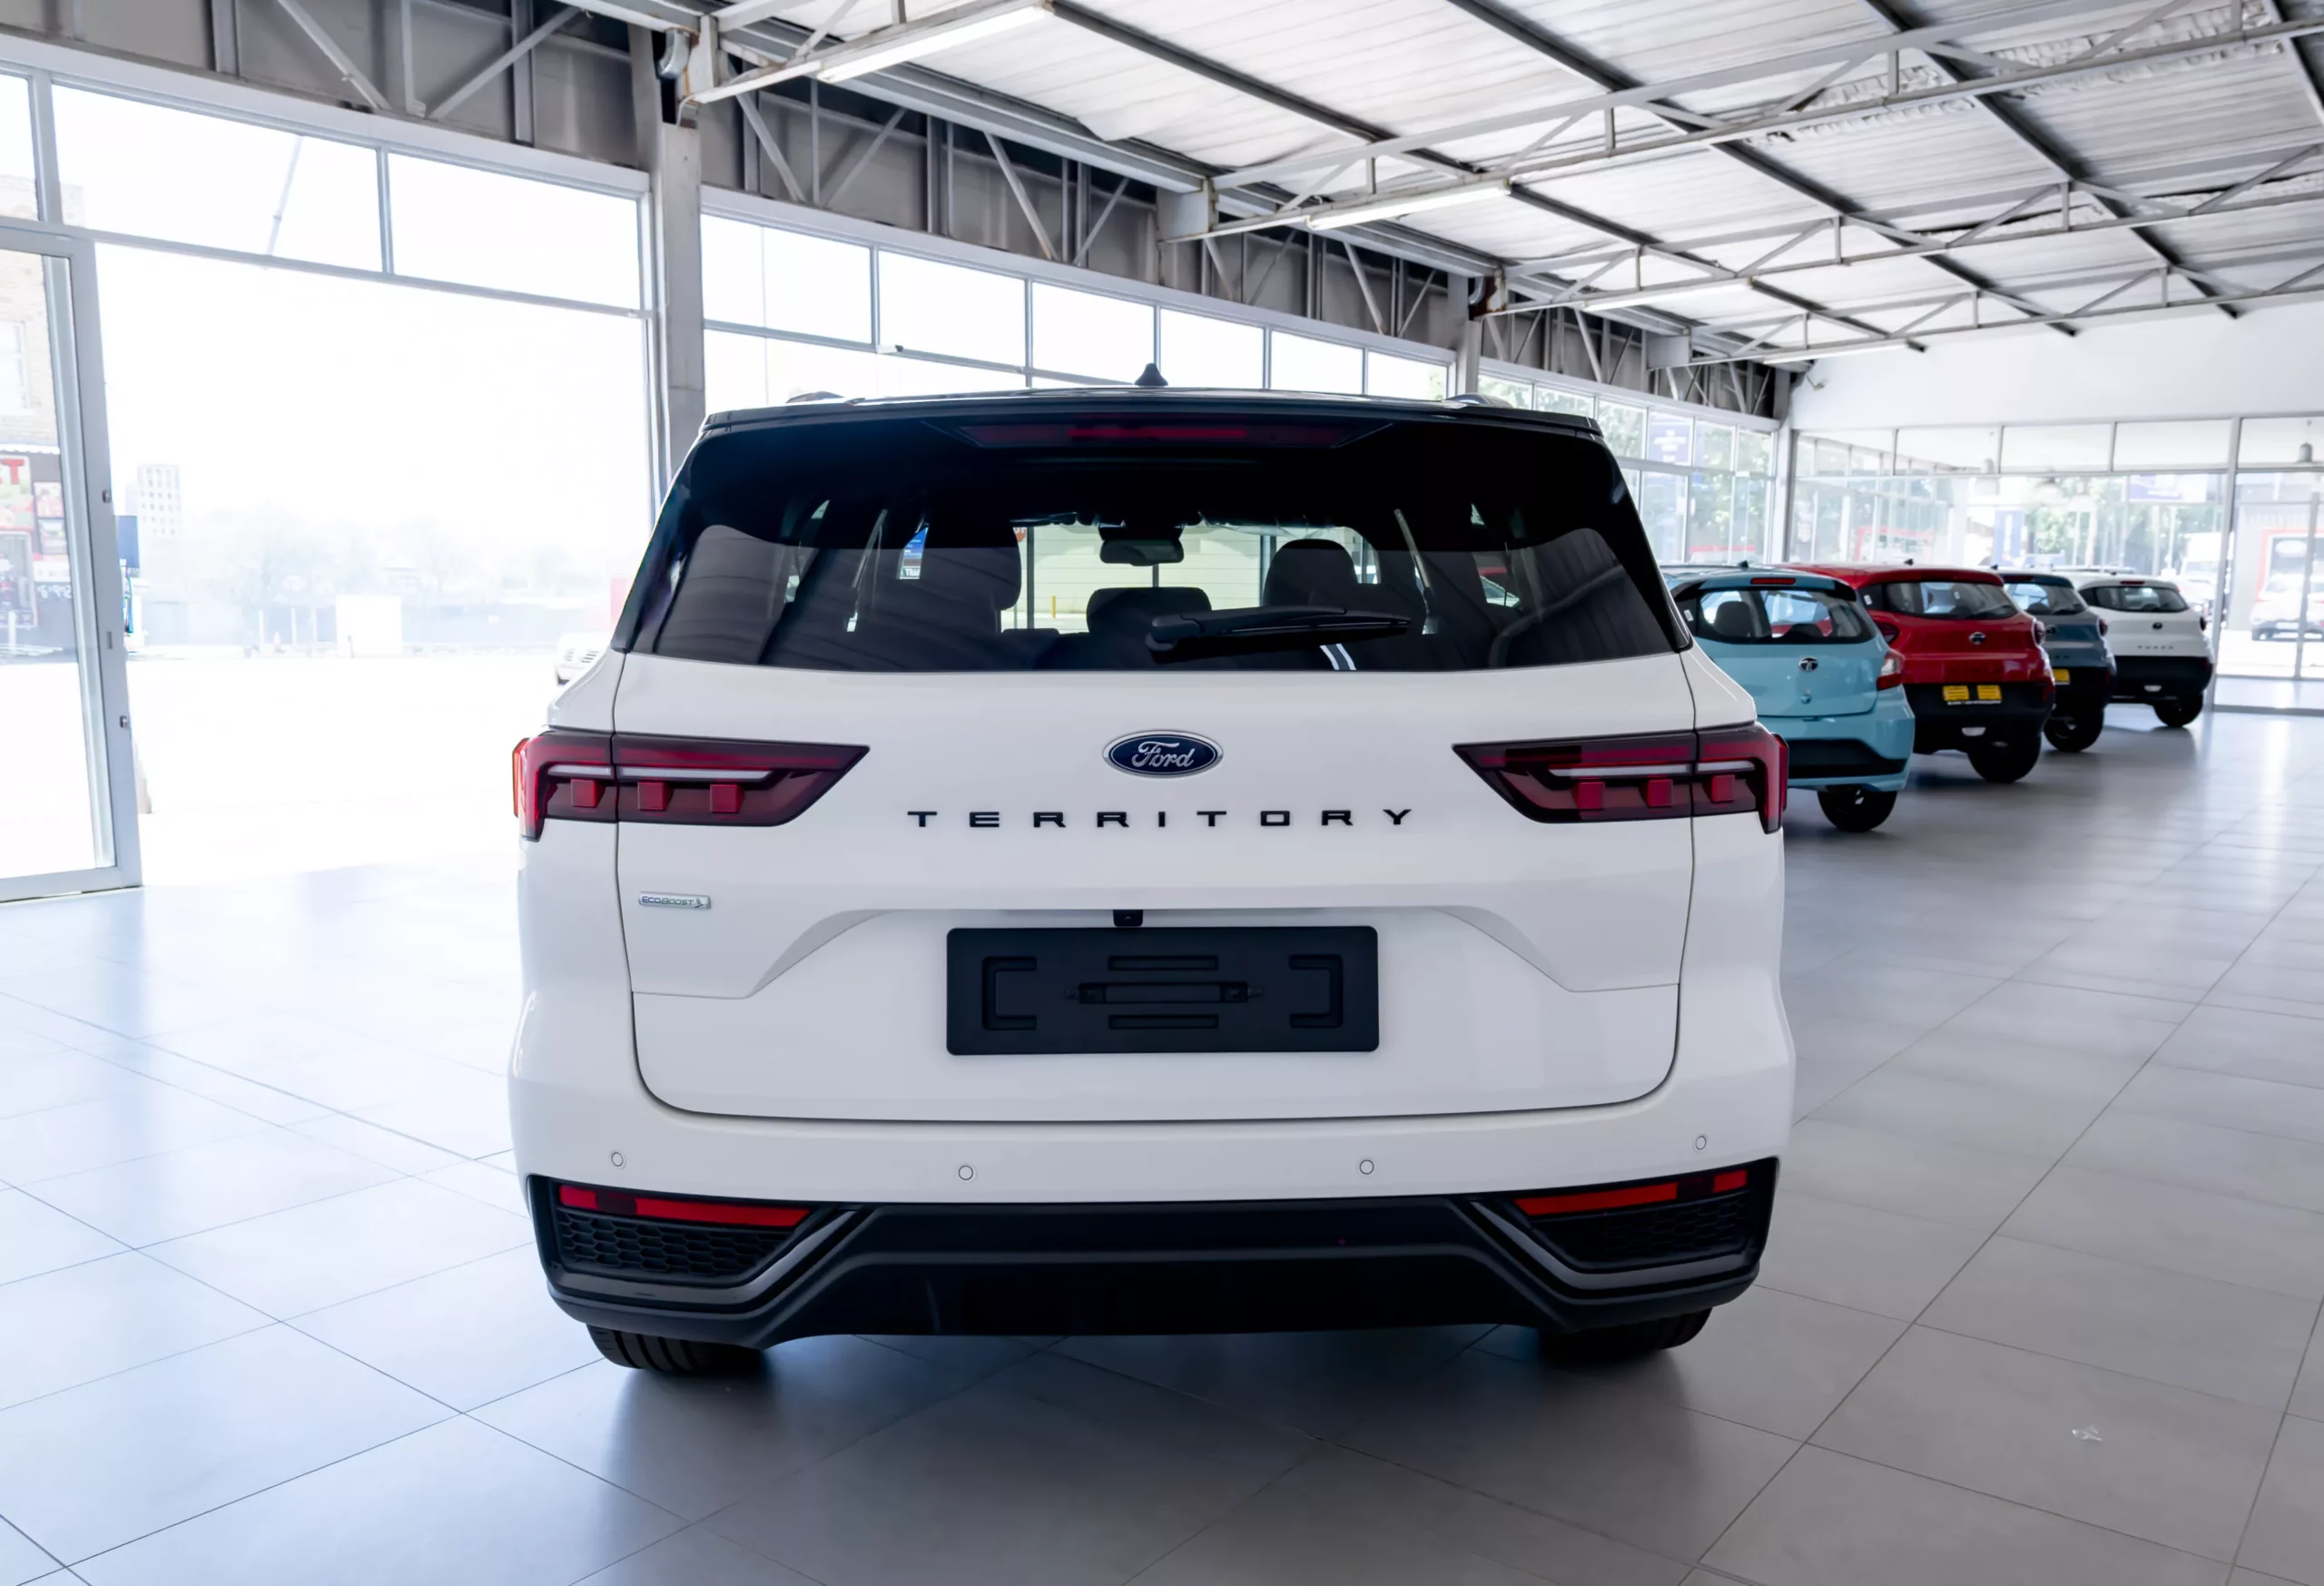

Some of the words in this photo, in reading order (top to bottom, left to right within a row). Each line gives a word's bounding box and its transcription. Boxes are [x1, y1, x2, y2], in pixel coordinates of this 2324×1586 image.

[1131, 741, 1196, 767] Ford
[907, 809, 1412, 828] TERRITORY
[641, 895, 694, 906] ECOBOOST
